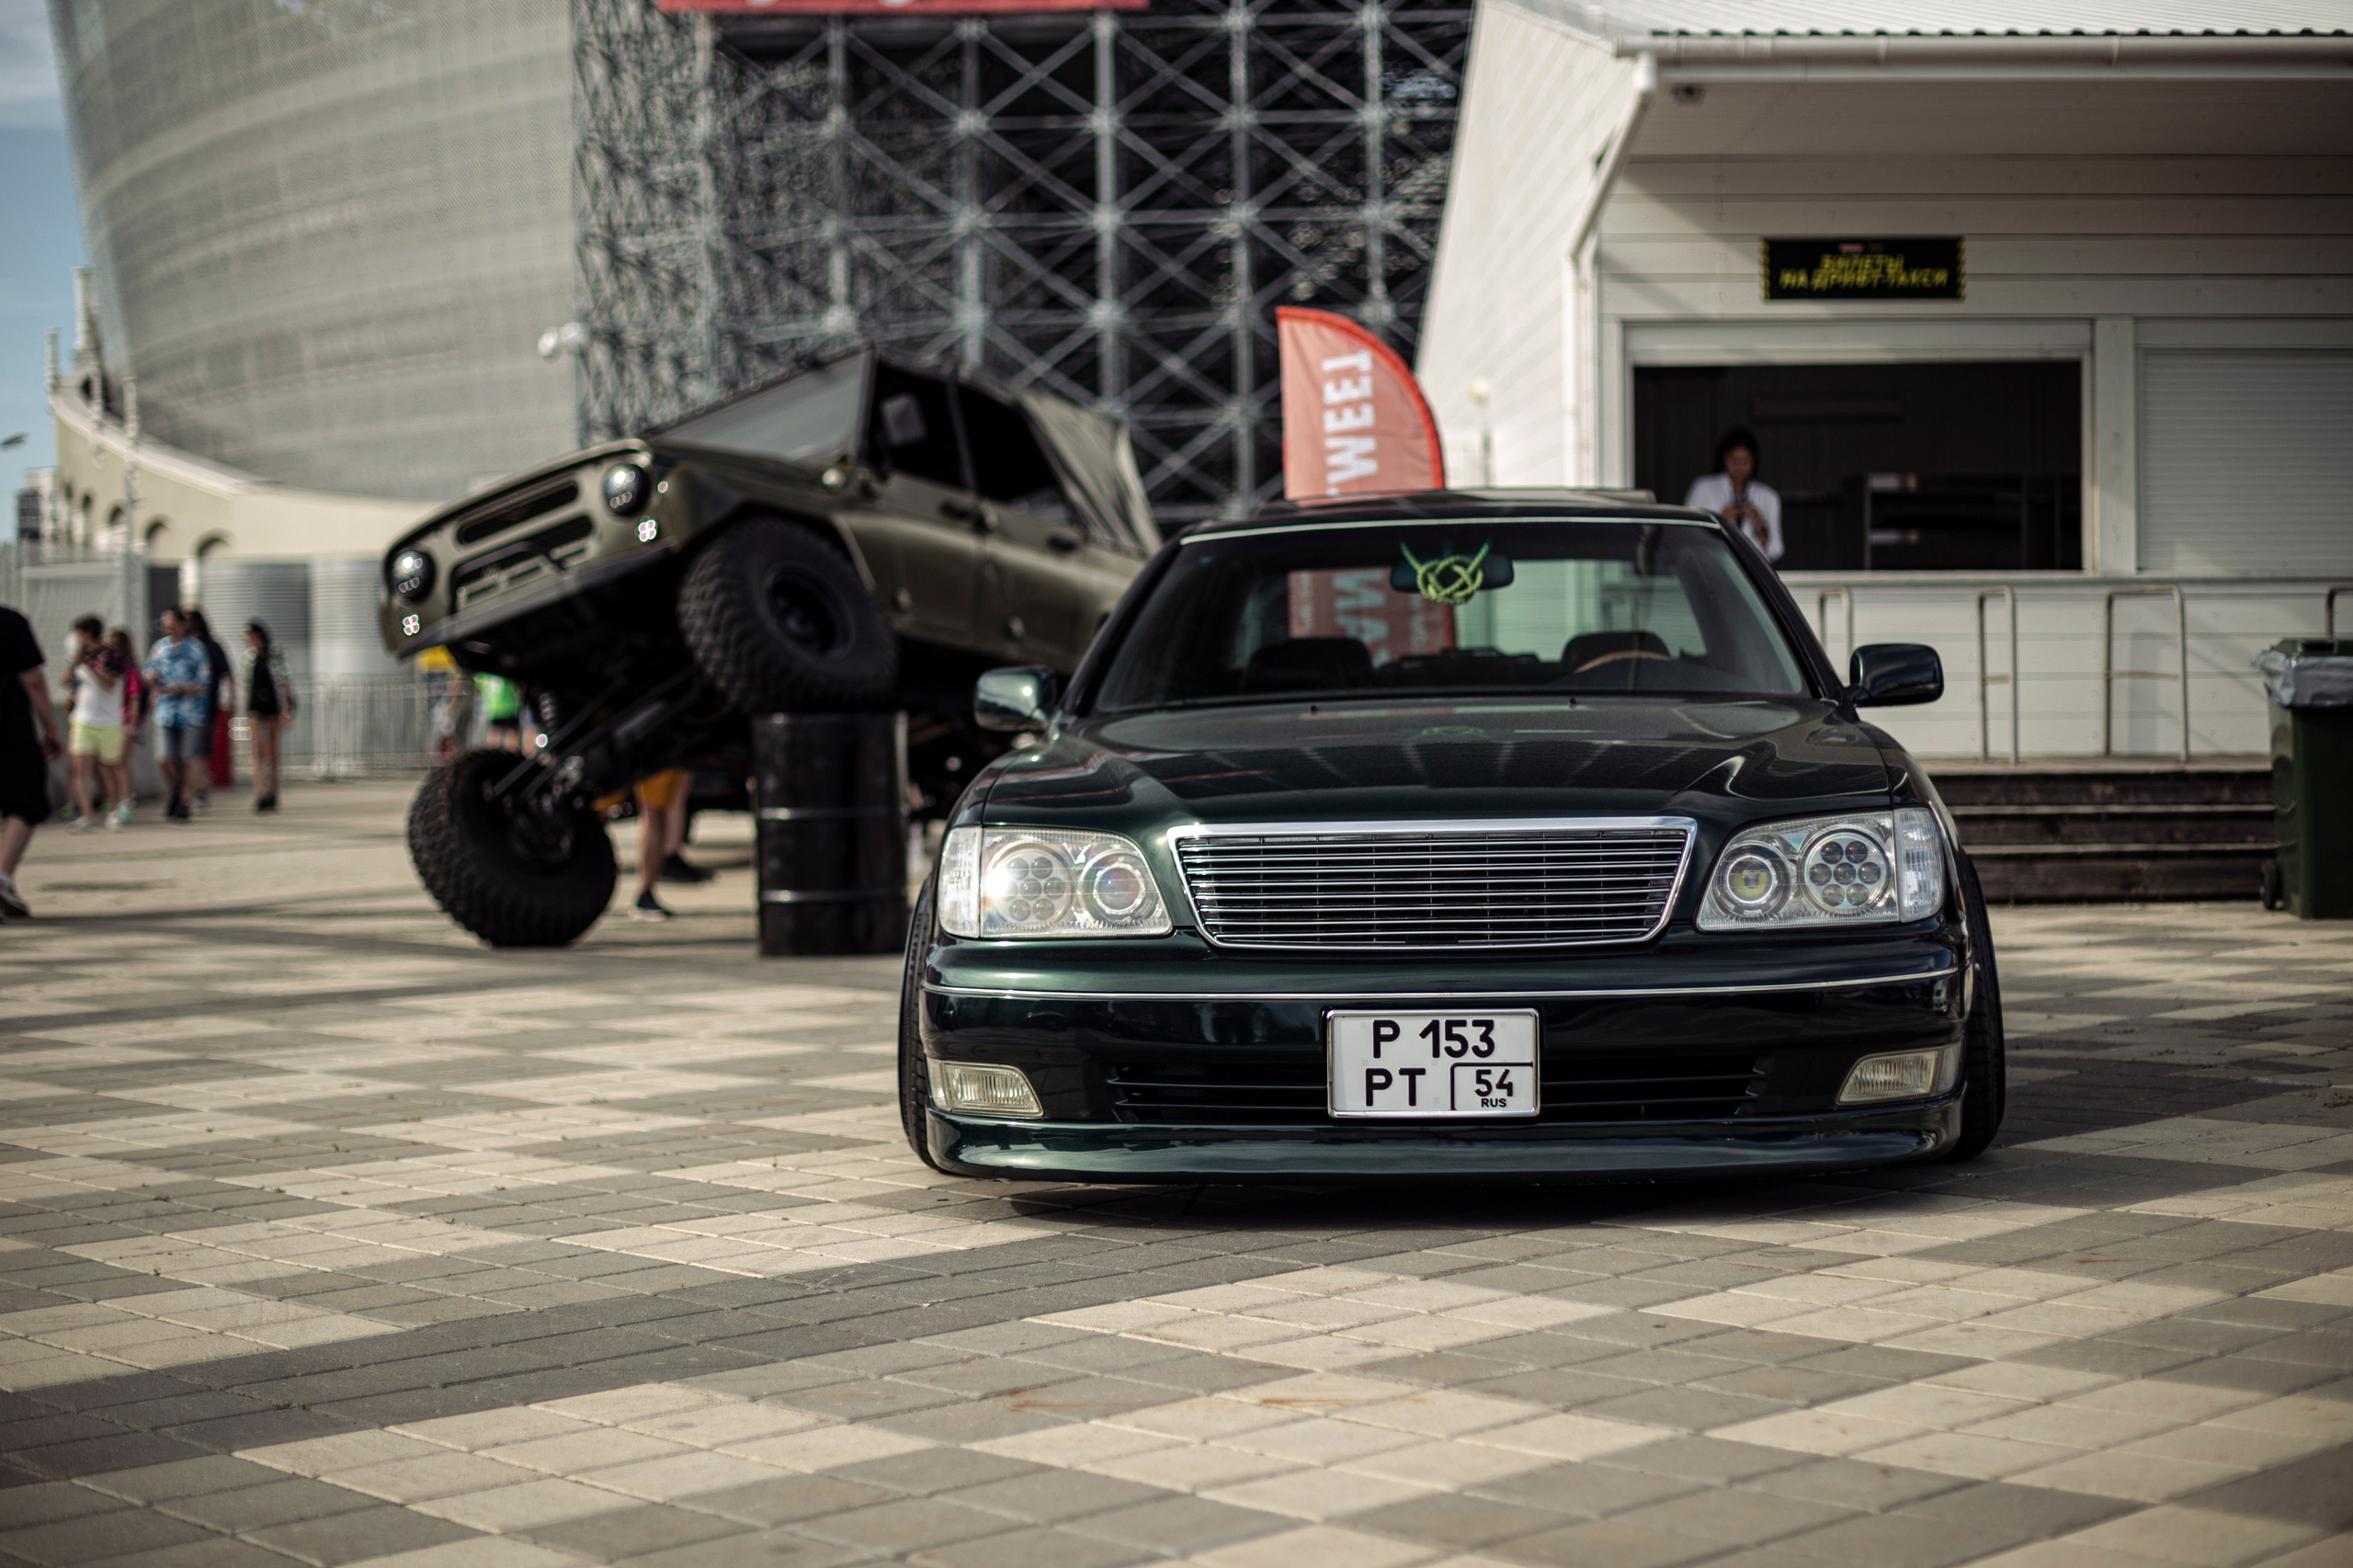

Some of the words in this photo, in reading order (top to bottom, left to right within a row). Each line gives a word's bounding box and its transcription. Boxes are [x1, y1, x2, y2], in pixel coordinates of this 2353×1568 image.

[1821, 255, 1904, 273] БИЛЕТЫ
[1779, 268, 1809, 290] НА
[1418, 1019, 1495, 1058] 153
[1474, 1069, 1514, 1097] 54
[1481, 1097, 1507, 1108] RUS
